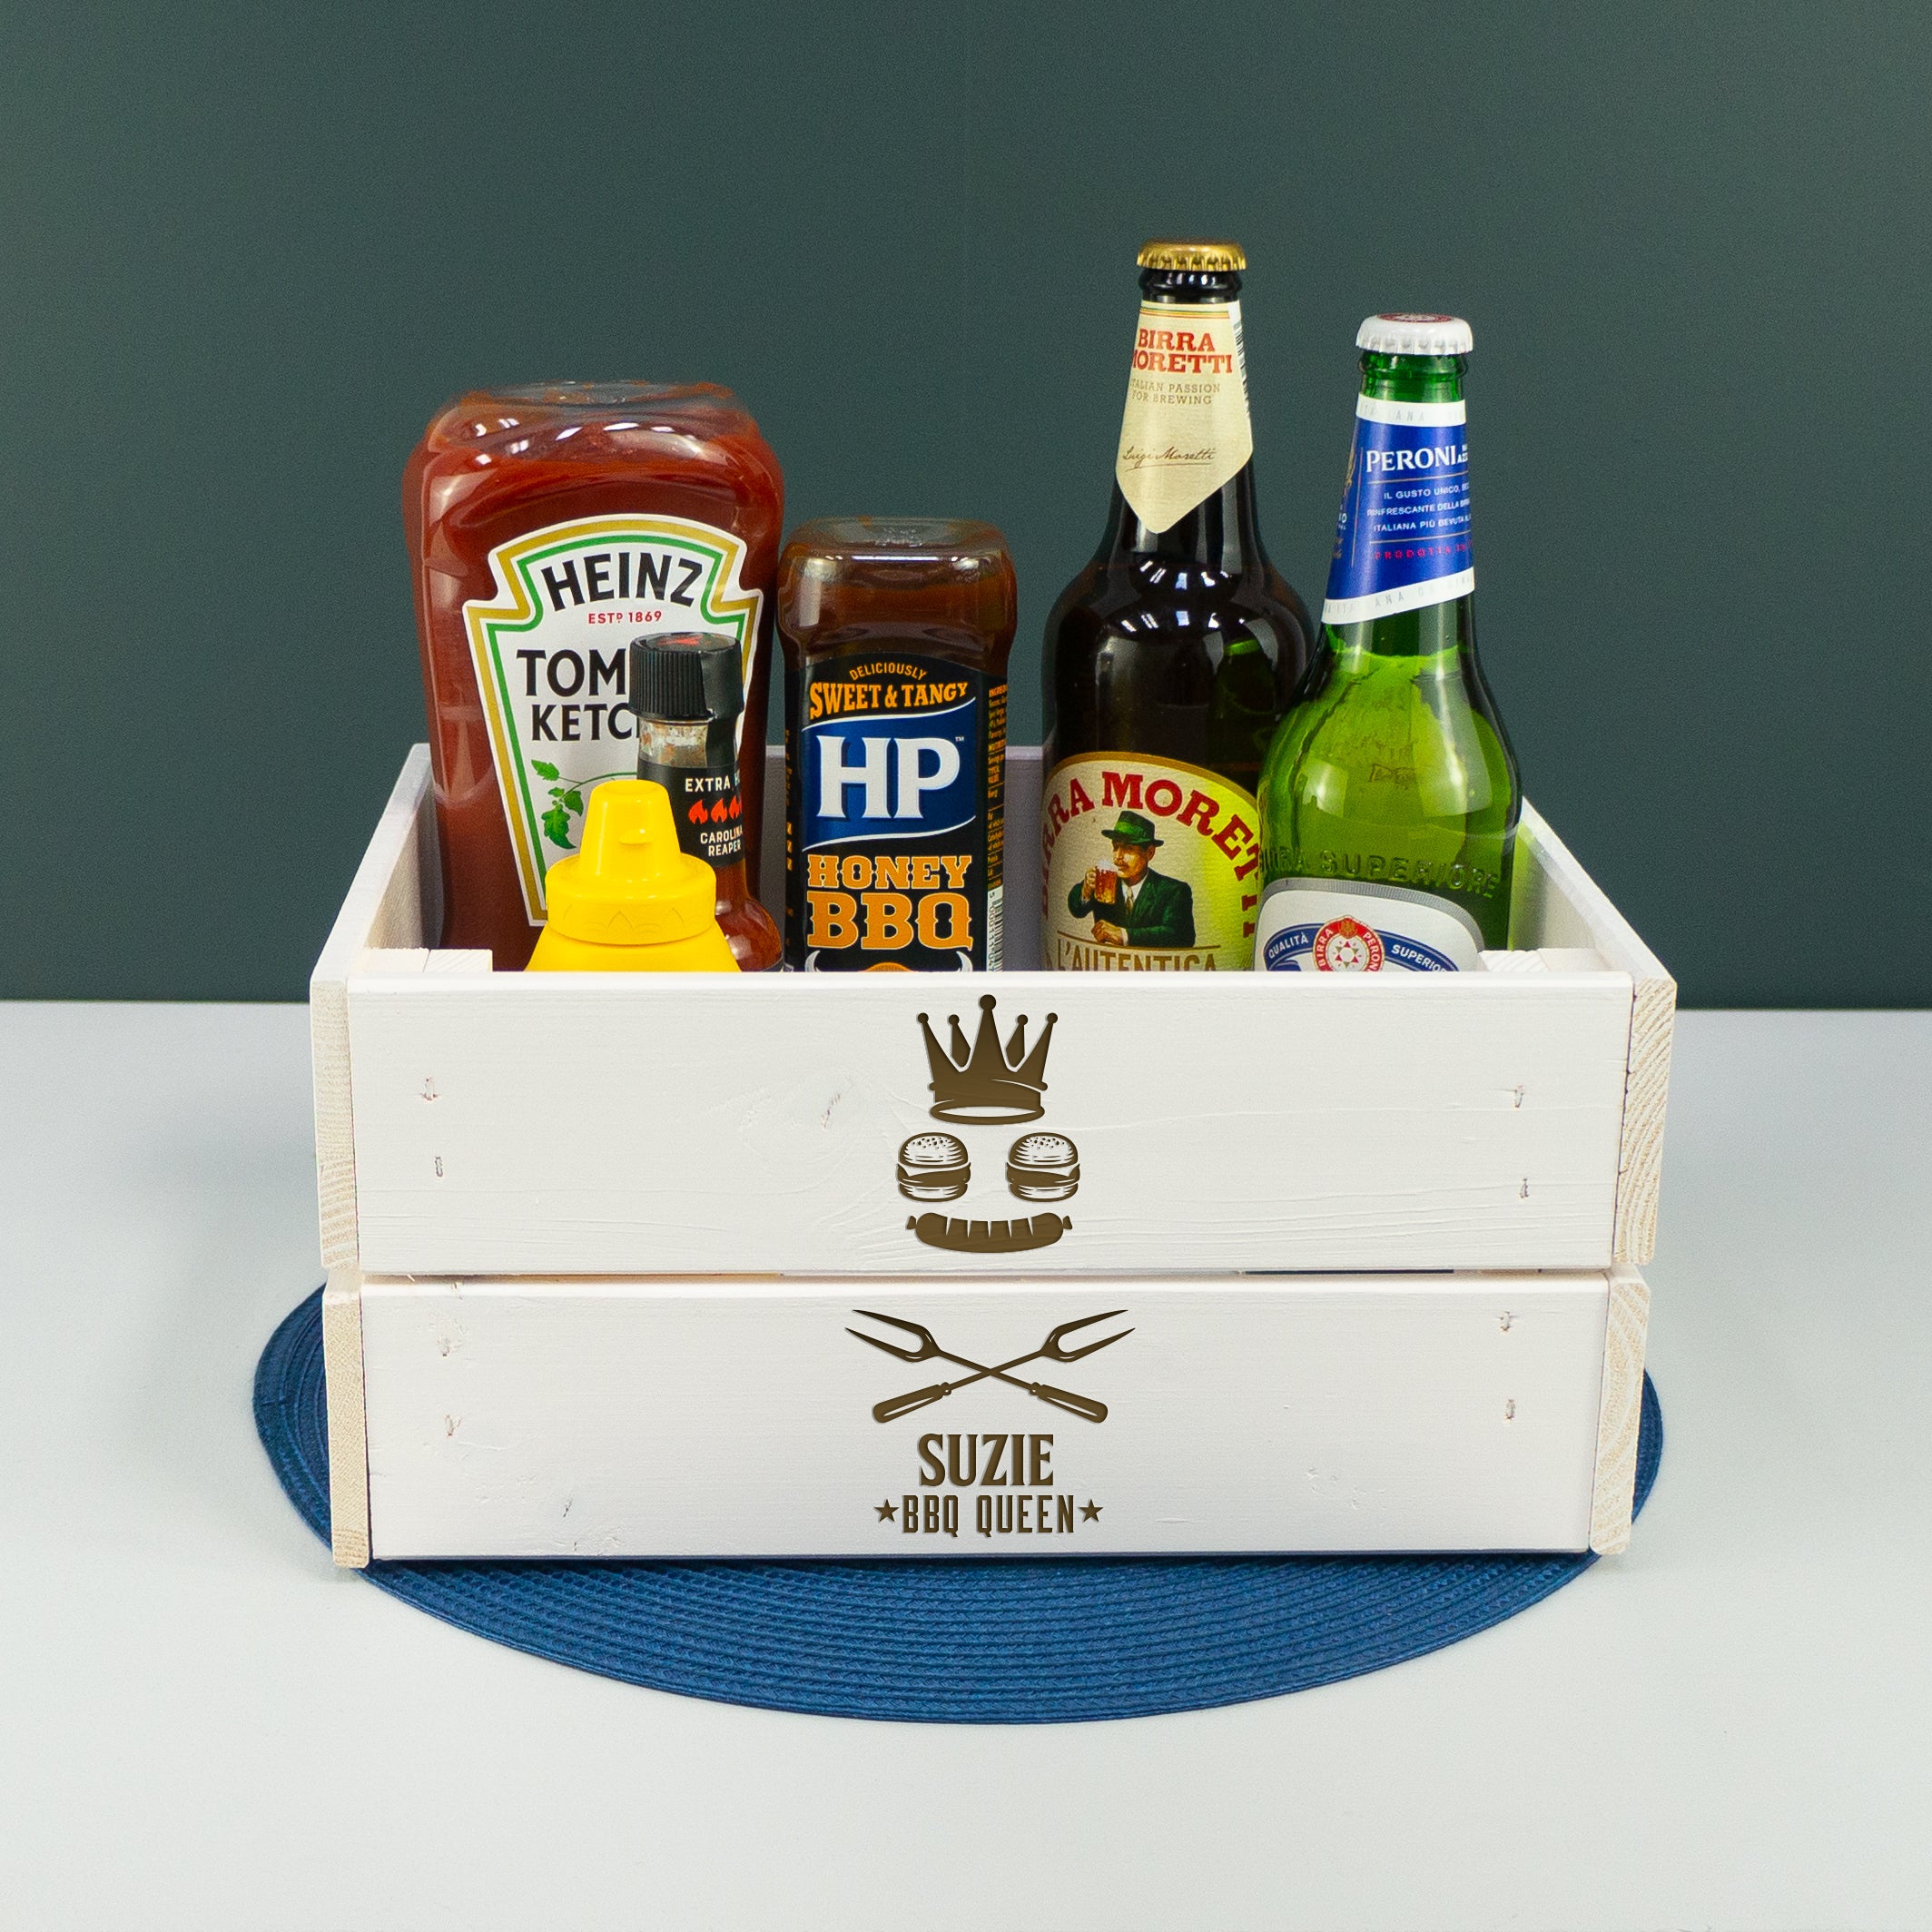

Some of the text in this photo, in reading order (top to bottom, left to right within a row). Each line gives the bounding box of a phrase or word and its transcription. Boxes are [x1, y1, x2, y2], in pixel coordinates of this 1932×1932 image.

[1138, 329, 1216, 352] BIRRA
[1152, 395, 1212, 405] BREWING
[1168, 383, 1220, 394] PASSION
[1155, 446, 1216, 460] Moretti
[1365, 445, 1456, 473] PERONI
[1383, 491, 1393, 499] IL
[1395, 488, 1432, 499] GUSTO
[1366, 504, 1435, 517] RINFRESCANTE
[1373, 522, 1416, 532] ITALIANA
[540, 551, 703, 612] HEINZ
[628, 611, 662, 624] 1869
[516, 647, 626, 697] TOM
[849, 662, 928, 682] DELICIOUSLY
[809, 682, 969, 721] SWEET & TANGY
[531, 702, 640, 742] KETC
[685, 775, 731, 793] EXTRA
[815, 734, 961, 819] HP
[700, 824, 744, 844] CAROLINA
[708, 839, 742, 857] REAPER
[1101, 771, 1260, 939] MORET
[806, 854, 972, 890] HONEY
[806, 891, 974, 952] BBQ
[1268, 932, 1309, 959] QUALITÀ
[1317, 928, 1381, 971] BIRRA PERON
[917, 1433, 1055, 1488] SUZIE
[902, 1494, 1076, 1538] BBQ QUEEN
